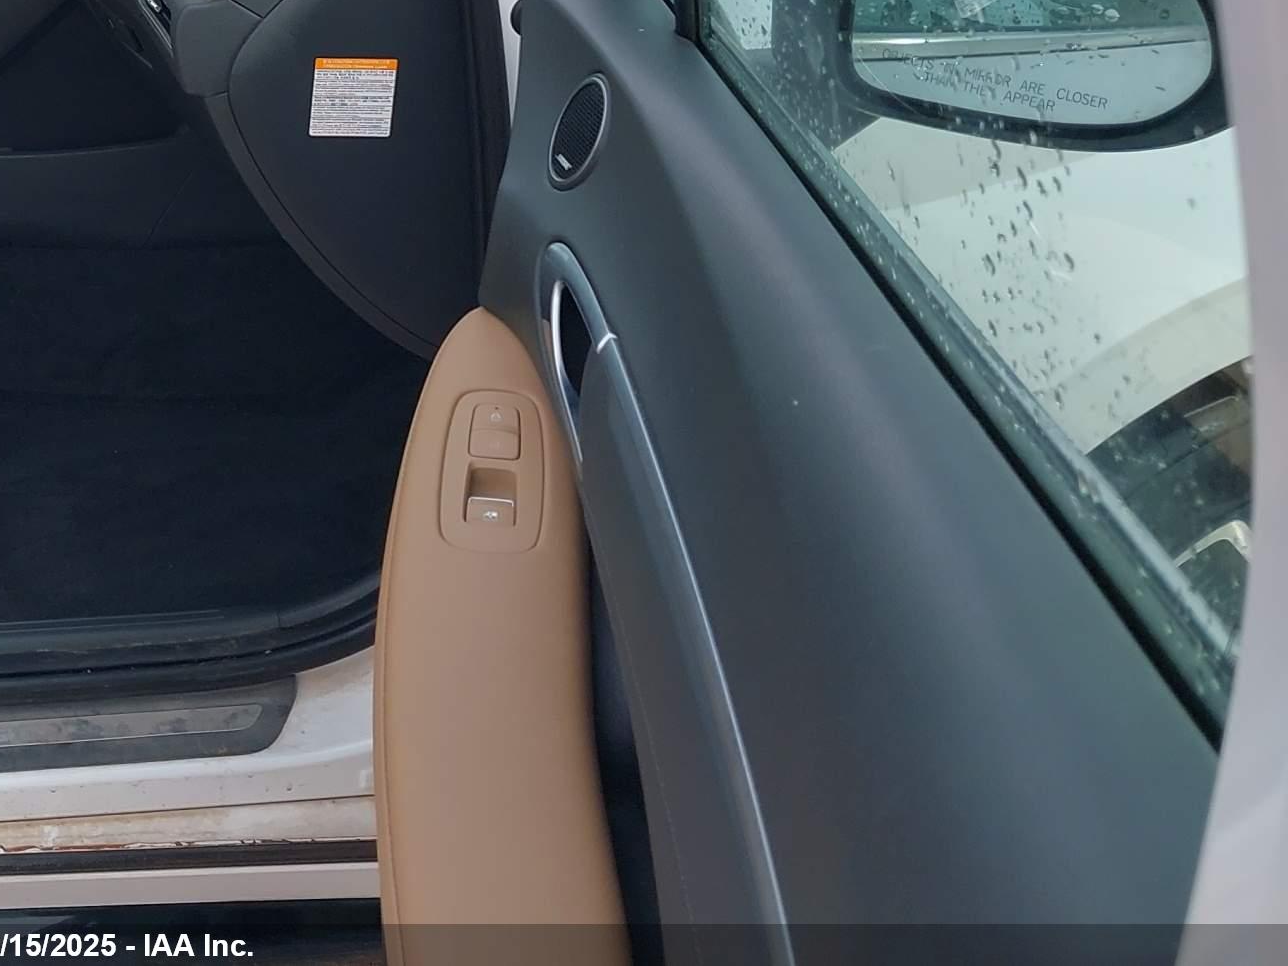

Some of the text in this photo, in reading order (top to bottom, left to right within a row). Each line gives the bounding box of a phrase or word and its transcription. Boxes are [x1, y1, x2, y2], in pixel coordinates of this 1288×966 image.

[882, 49, 1109, 110] OBJECTS IN MIRROR ARE CLOSER
[925, 72, 1056, 111] THAN THEY APPEAR
